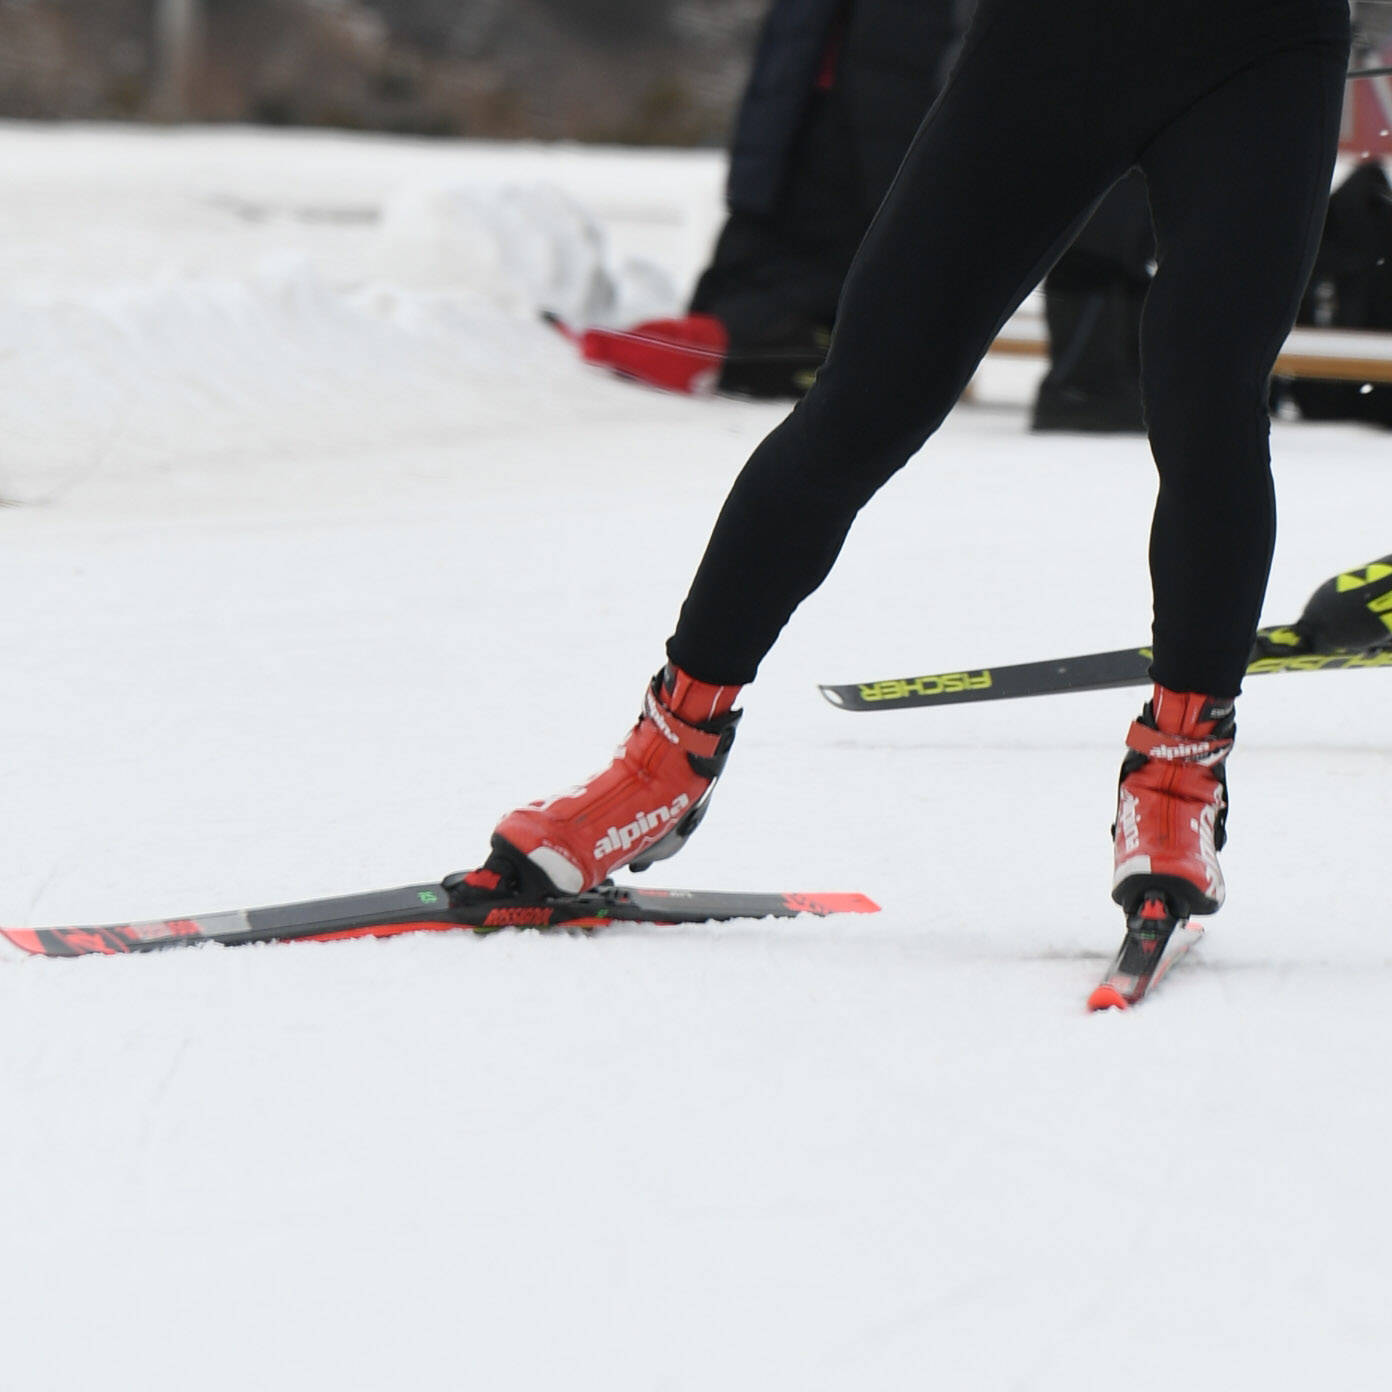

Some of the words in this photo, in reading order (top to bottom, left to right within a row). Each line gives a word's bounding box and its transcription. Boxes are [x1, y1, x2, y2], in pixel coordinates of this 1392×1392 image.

[858, 669, 993, 703] FISCHER
[1149, 741, 1211, 762] alpina
[593, 792, 689, 861] alpina
